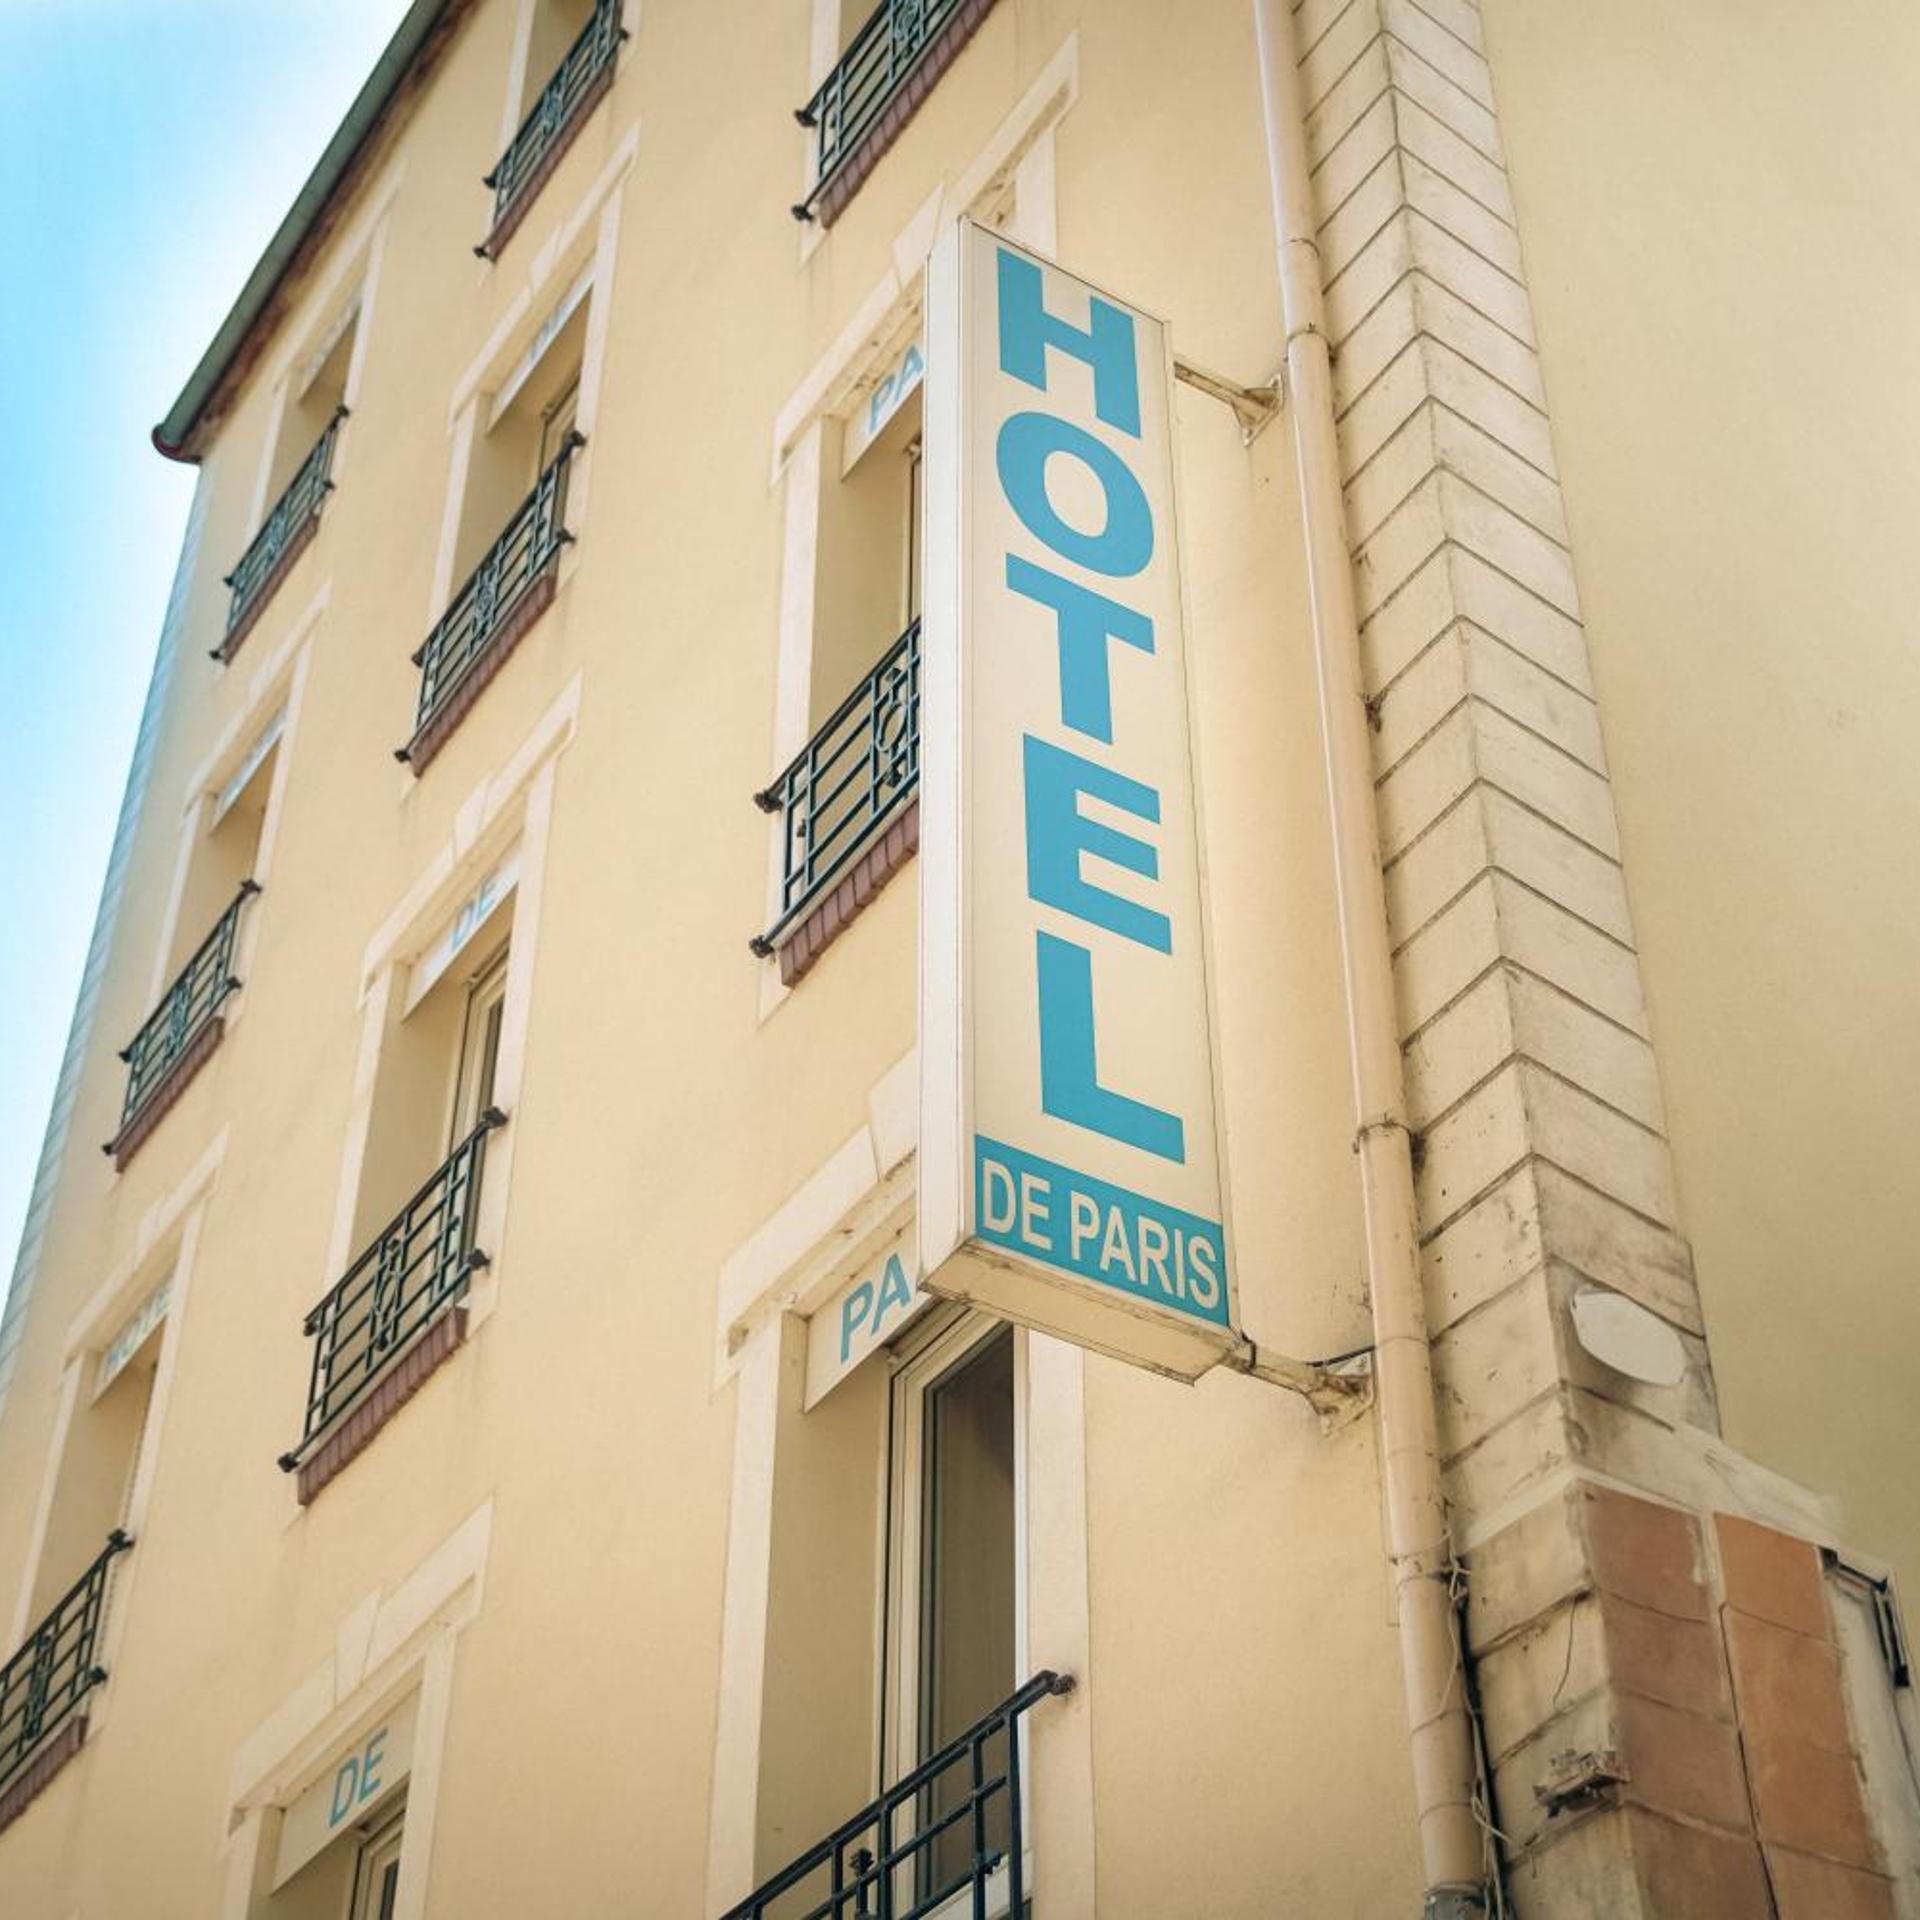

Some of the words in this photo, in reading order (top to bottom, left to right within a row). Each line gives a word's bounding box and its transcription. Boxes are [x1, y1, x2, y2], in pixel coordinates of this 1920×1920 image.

[997, 250, 1186, 1164] HOTEL
[983, 1158, 1052, 1250] DE
[1070, 1190, 1220, 1309] PARIS
[840, 1252, 911, 1364] PA
[329, 1728, 388, 1828] DE
